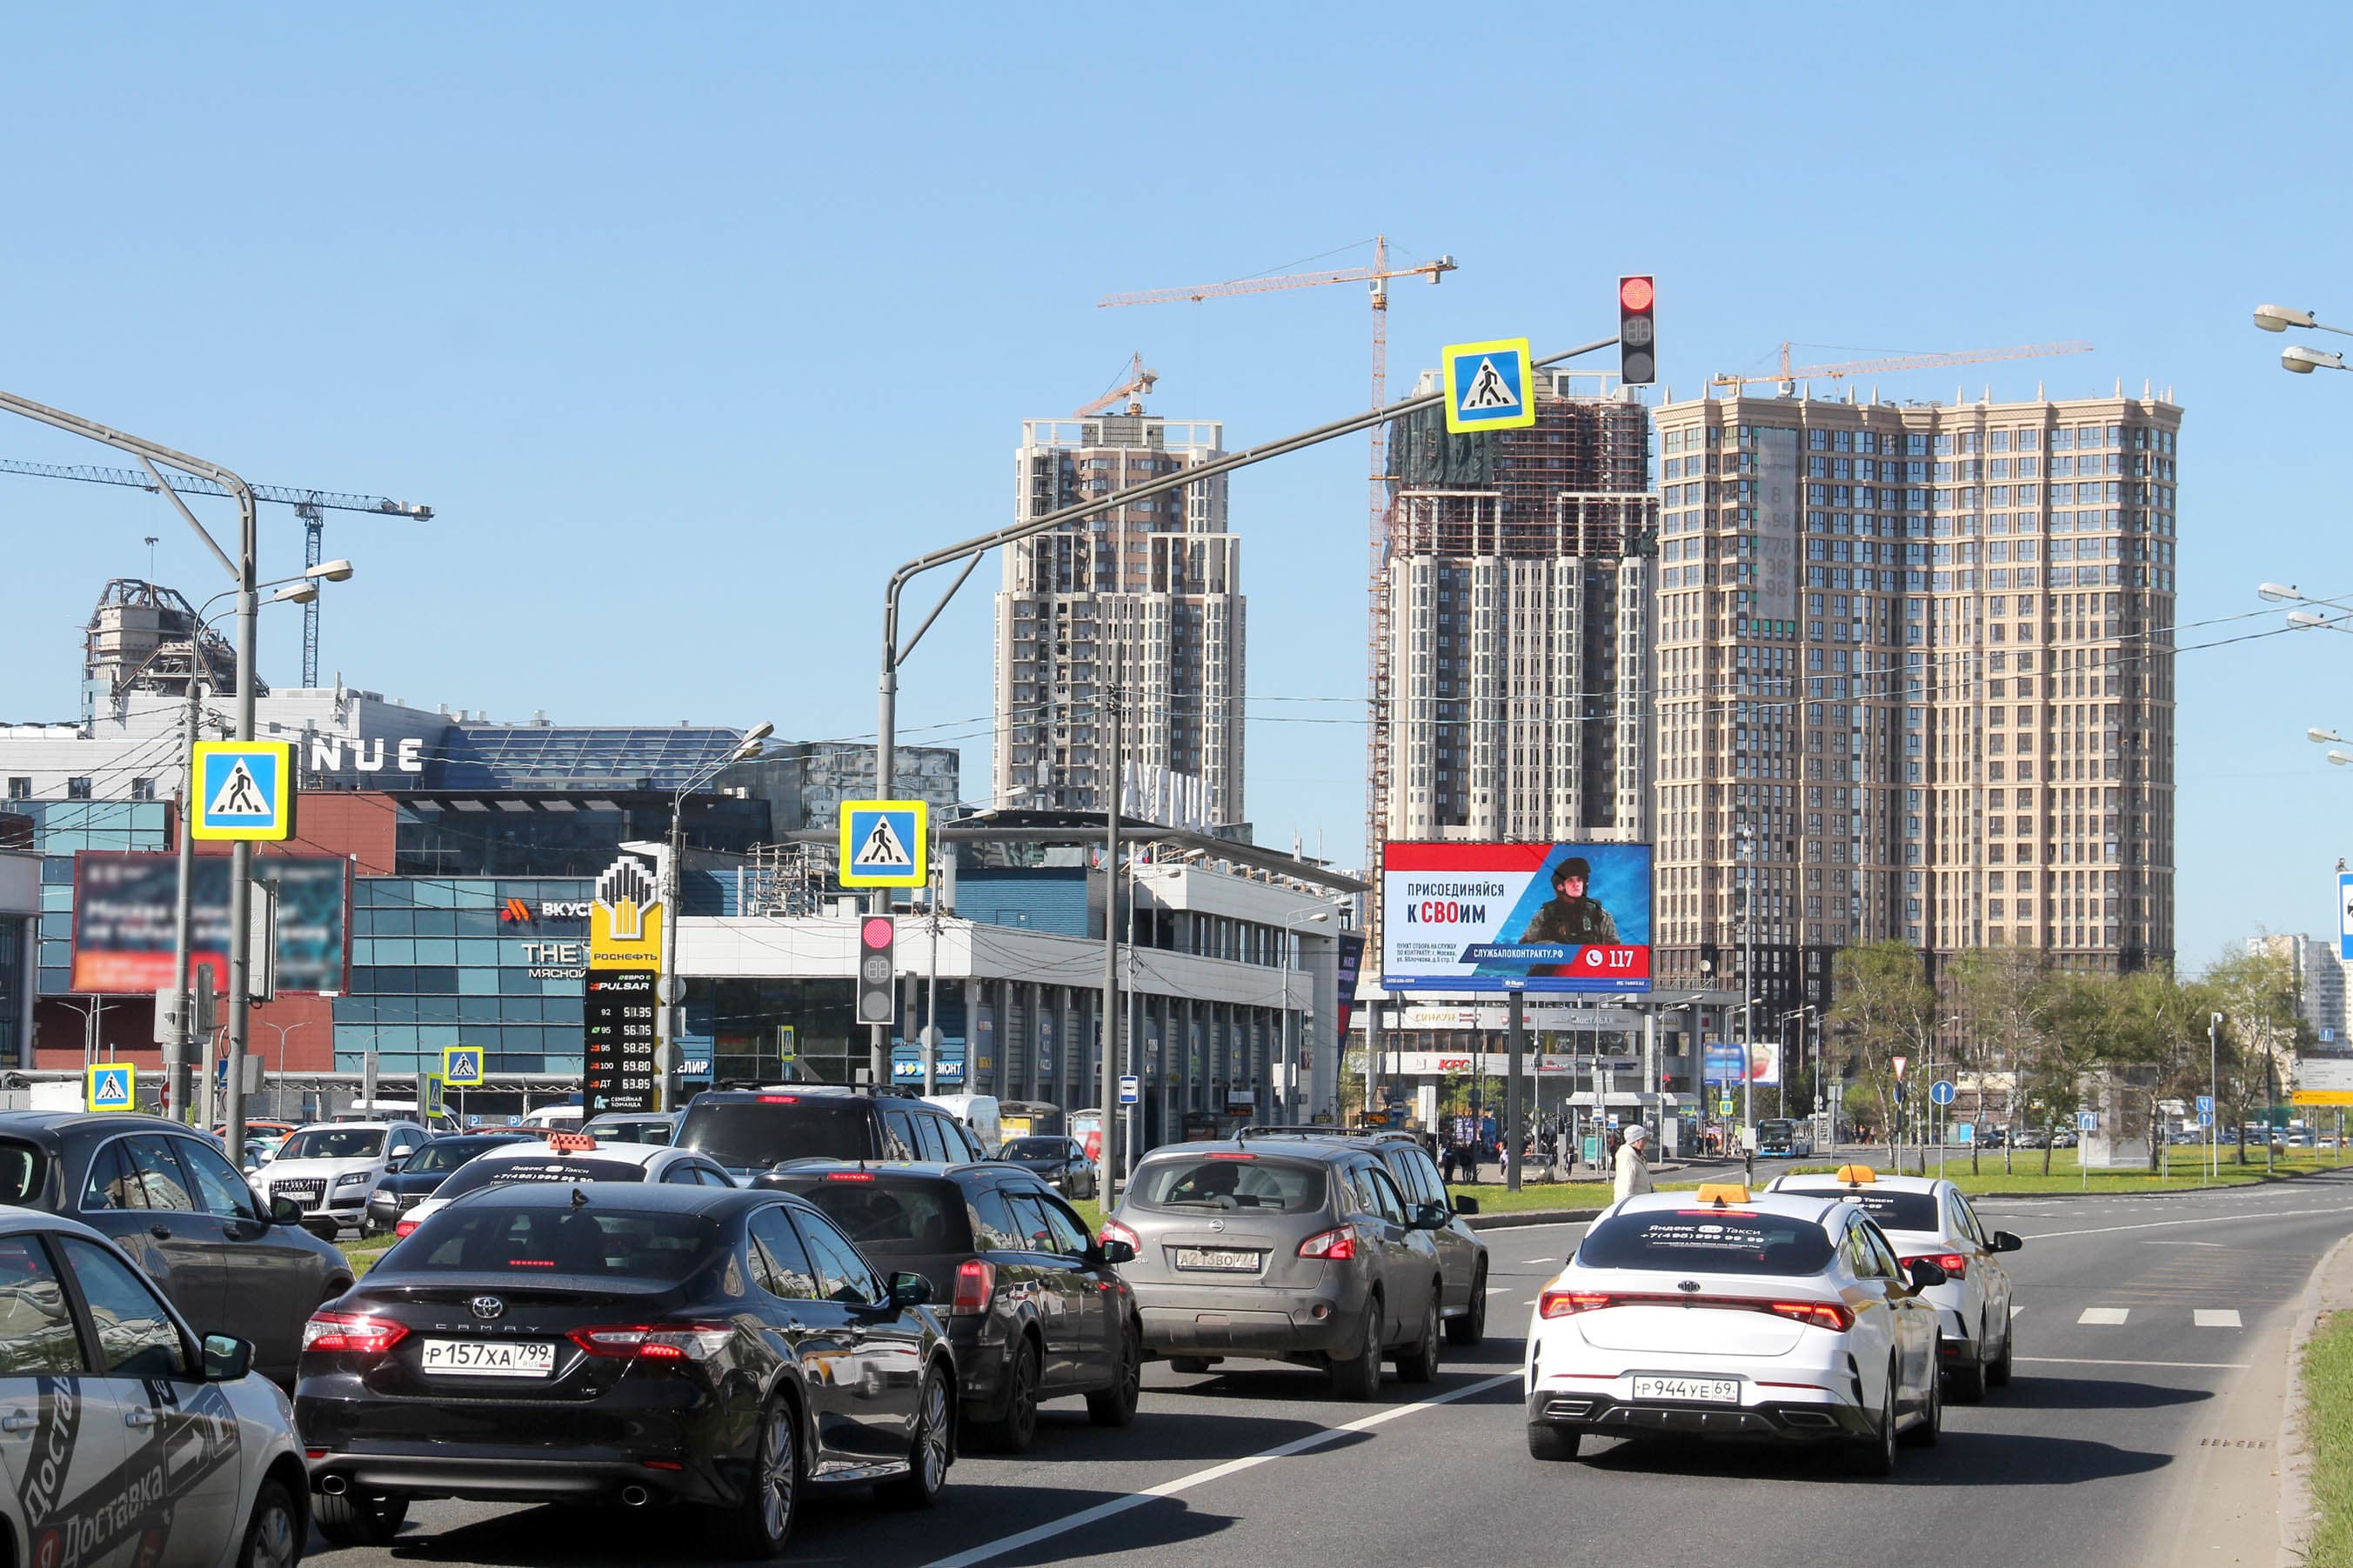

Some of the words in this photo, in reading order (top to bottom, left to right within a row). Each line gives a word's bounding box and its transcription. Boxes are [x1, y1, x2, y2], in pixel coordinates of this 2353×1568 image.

[1771, 486, 1781, 503] 8
[1762, 513, 1790, 528] 495
[1407, 881, 1505, 897] ПРИСОЕДИНЯЙСЯ
[1407, 904, 1418, 923] К
[522, 944, 578, 962] THE
[1474, 948, 1564, 959] СЛУЖБАПОКОНТРАКТУ.РФ
[1608, 950, 1634, 967] 117
[528, 967, 586, 978] МЯСНОЙ
[598, 982, 650, 991] PULSAR
[623, 1043, 652, 1053] 58.25
[622, 1060, 652, 1071] 69.80
[675, 1061, 708, 1073] ЕЛИР
[1438, 1058, 1470, 1071] KFC
[599, 1079, 612, 1089] ДТ
[1725, 1226, 1761, 1236] Такси
[435, 1323, 540, 1332] CAMRY
[429, 1344, 511, 1366] Р157ХА
[517, 1344, 549, 1361] 799
[1641, 1380, 1710, 1398] Р944УЕ
[1715, 1382, 1732, 1395] 69
[61, 1465, 164, 1568] Доставка
